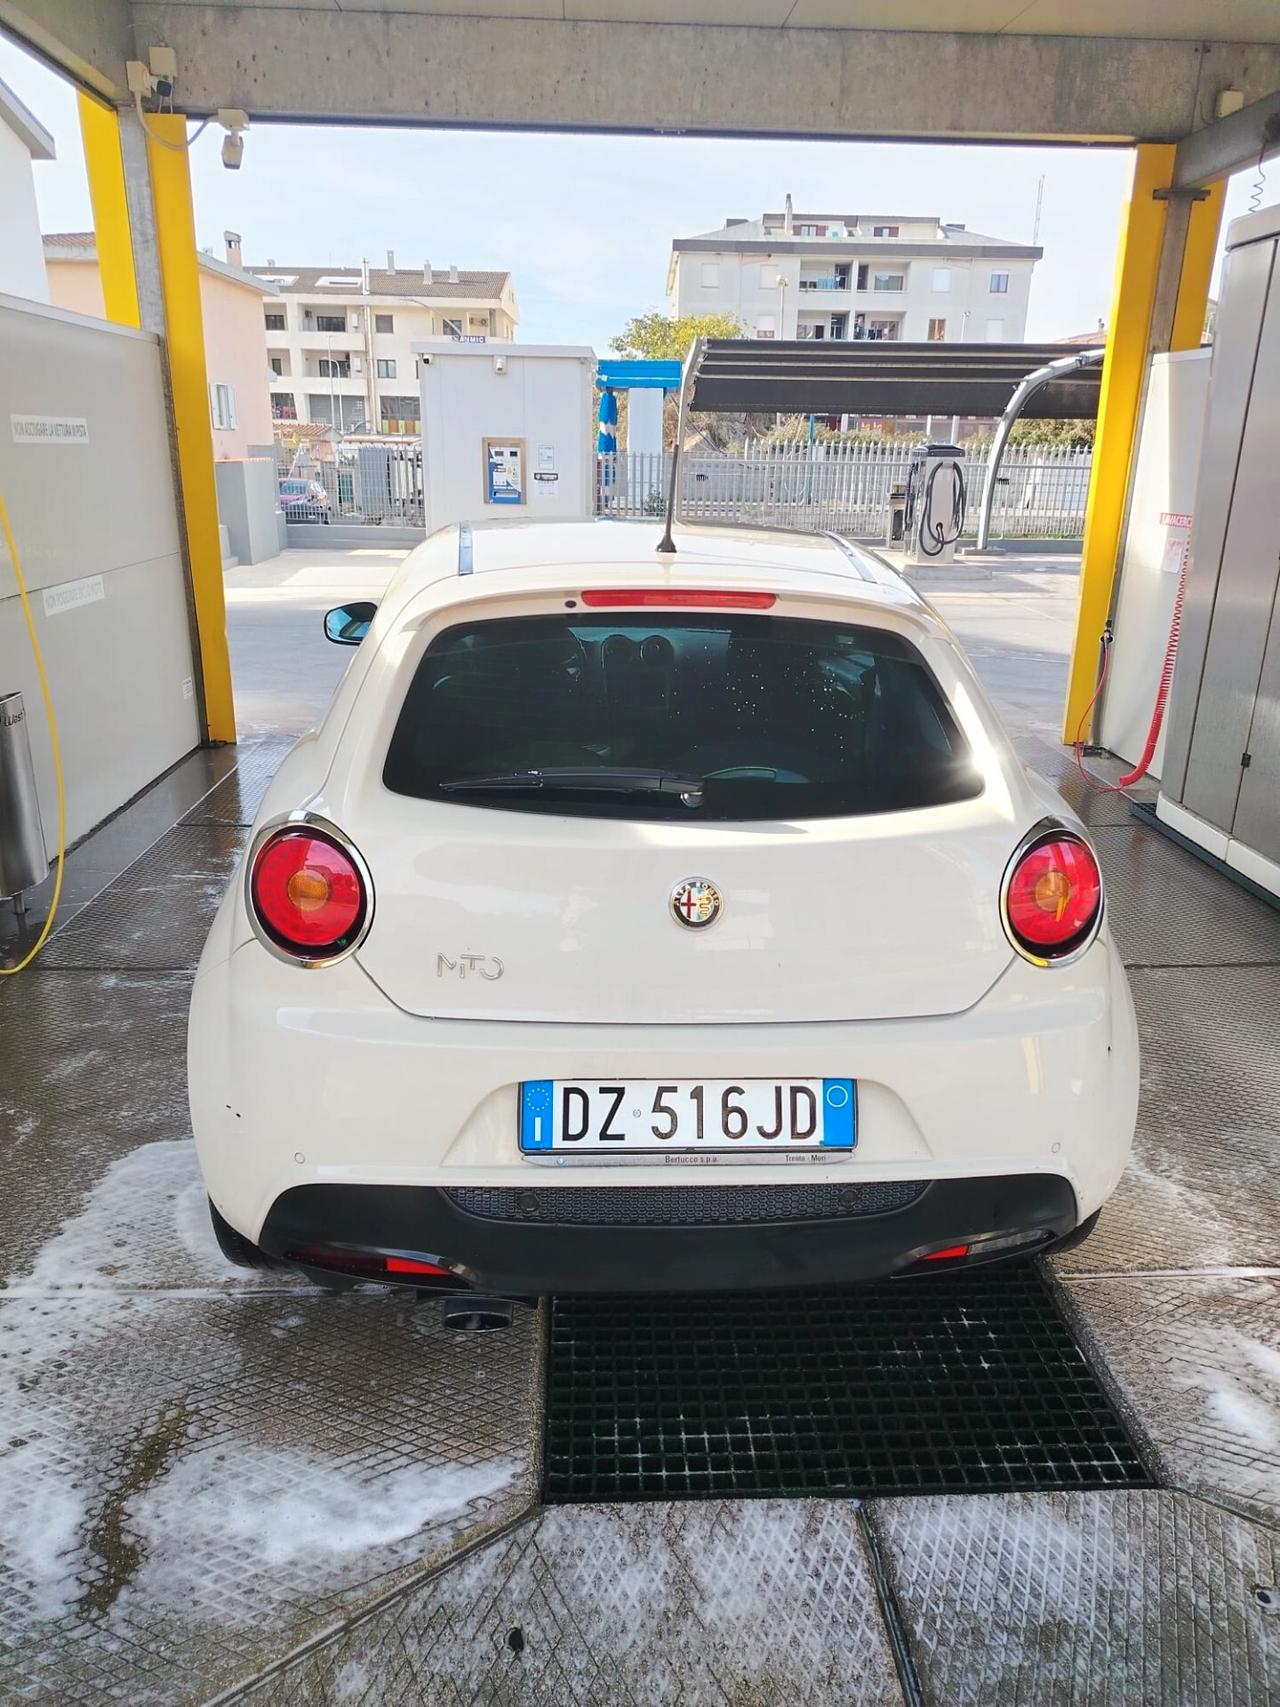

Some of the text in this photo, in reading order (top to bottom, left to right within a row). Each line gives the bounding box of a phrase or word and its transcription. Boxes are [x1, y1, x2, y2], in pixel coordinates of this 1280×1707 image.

[674, 881, 720, 906] ALFA ROMEO
[561, 1085, 818, 1142] DZ 516 JD
